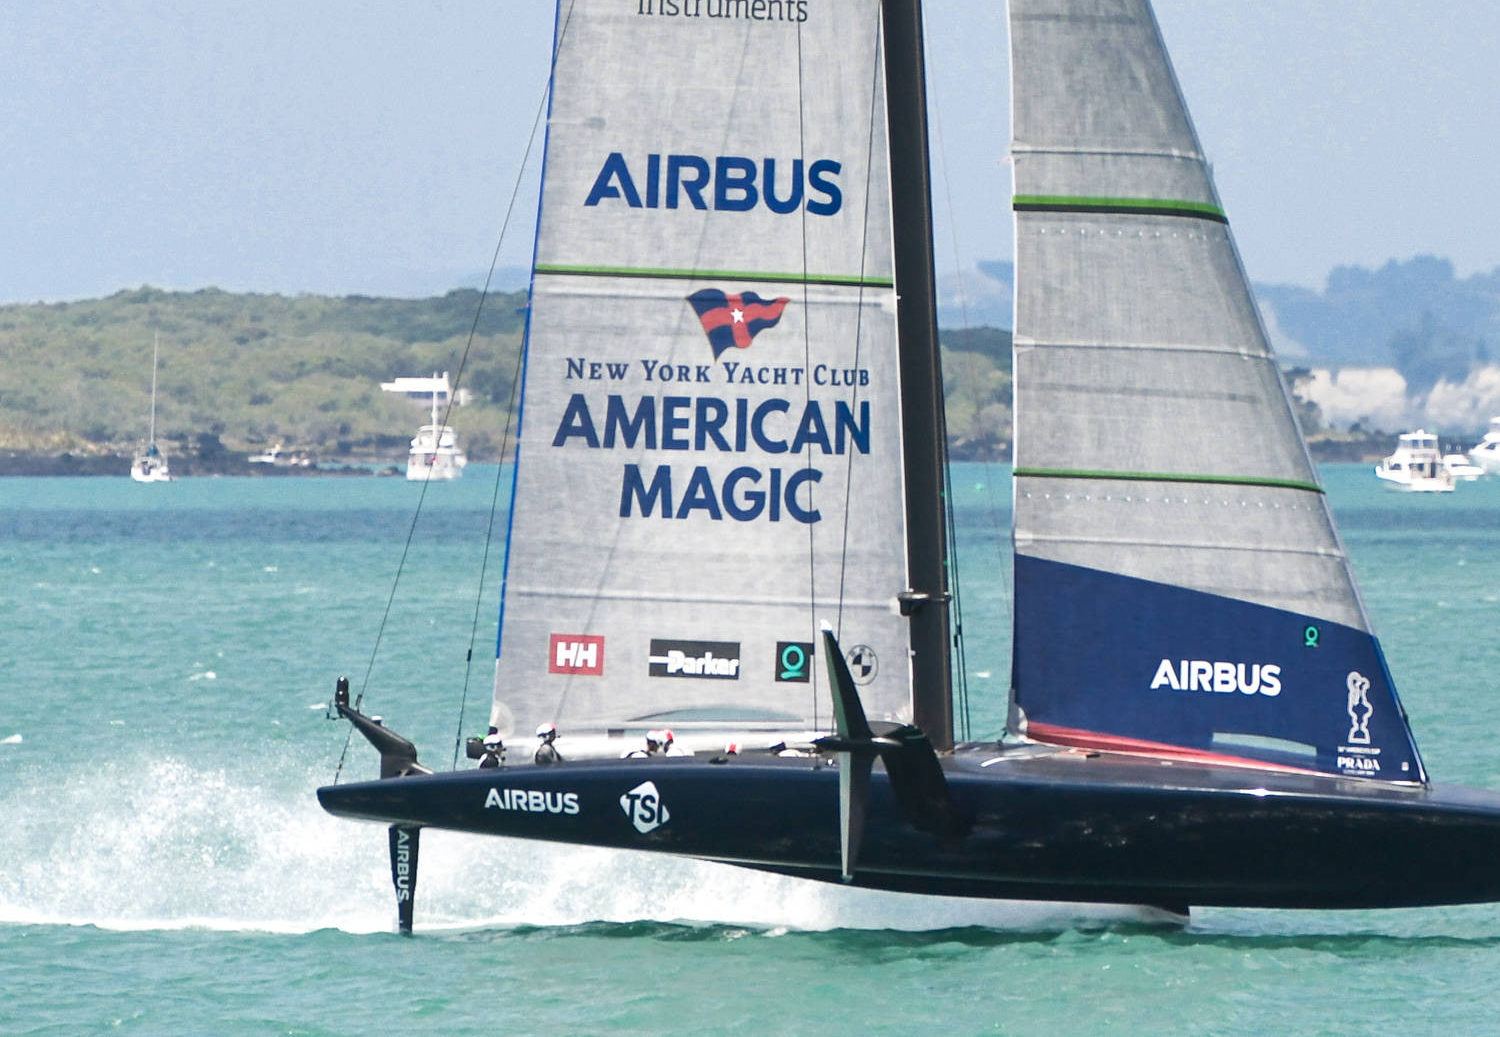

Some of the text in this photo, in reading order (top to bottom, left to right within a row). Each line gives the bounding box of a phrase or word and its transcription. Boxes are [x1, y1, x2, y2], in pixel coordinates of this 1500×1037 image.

[584, 152, 842, 217] AIRBUS
[565, 357, 870, 387] NEW YORK YACHT CLUB
[552, 393, 870, 454] AMERICAN
[619, 464, 823, 524] MAGIC
[556, 642, 597, 668] HH
[667, 650, 739, 676] Parker
[1150, 659, 1281, 697] AIRBUS
[1337, 756, 1381, 771] PRADA
[484, 788, 580, 815] AIRBUS
[626, 794, 663, 824] TSI
[397, 829, 409, 903] AIRBUS
